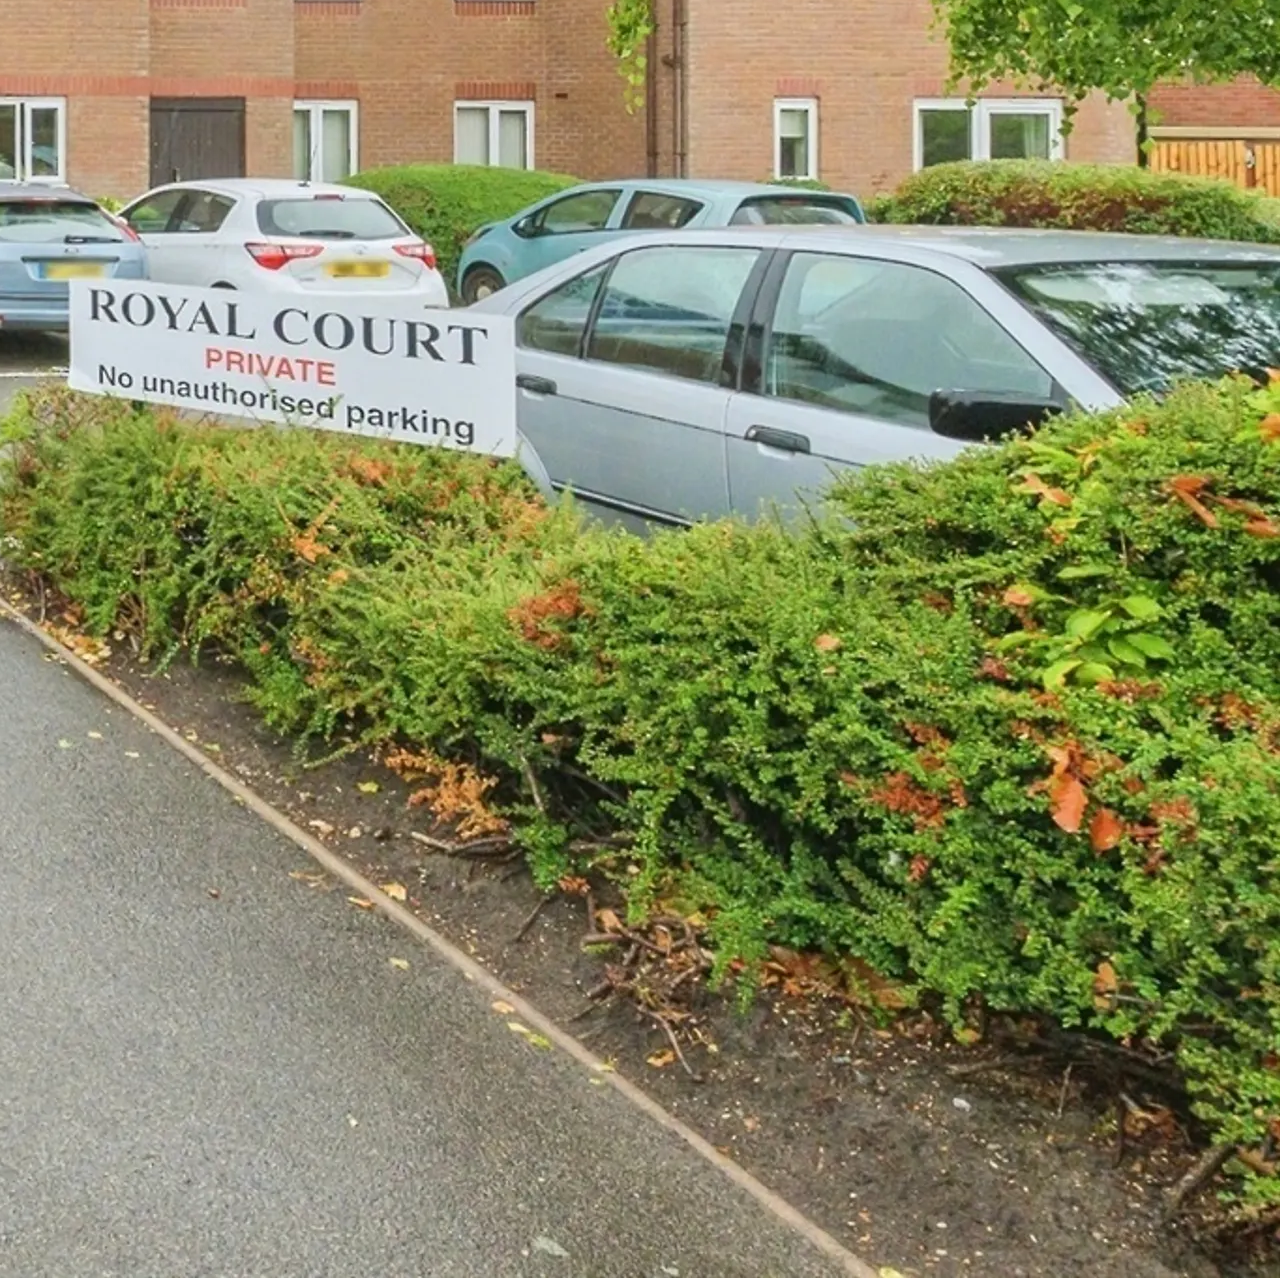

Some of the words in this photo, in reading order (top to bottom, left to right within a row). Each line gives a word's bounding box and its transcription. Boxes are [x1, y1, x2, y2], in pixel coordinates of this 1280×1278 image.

[89, 288, 256, 340] ROYAL
[273, 308, 489, 365] COURT
[98, 364, 134, 389] No
[143, 375, 334, 419] unauthorised
[346, 404, 475, 445] parking
[205, 347, 336, 386] PRIVATE
